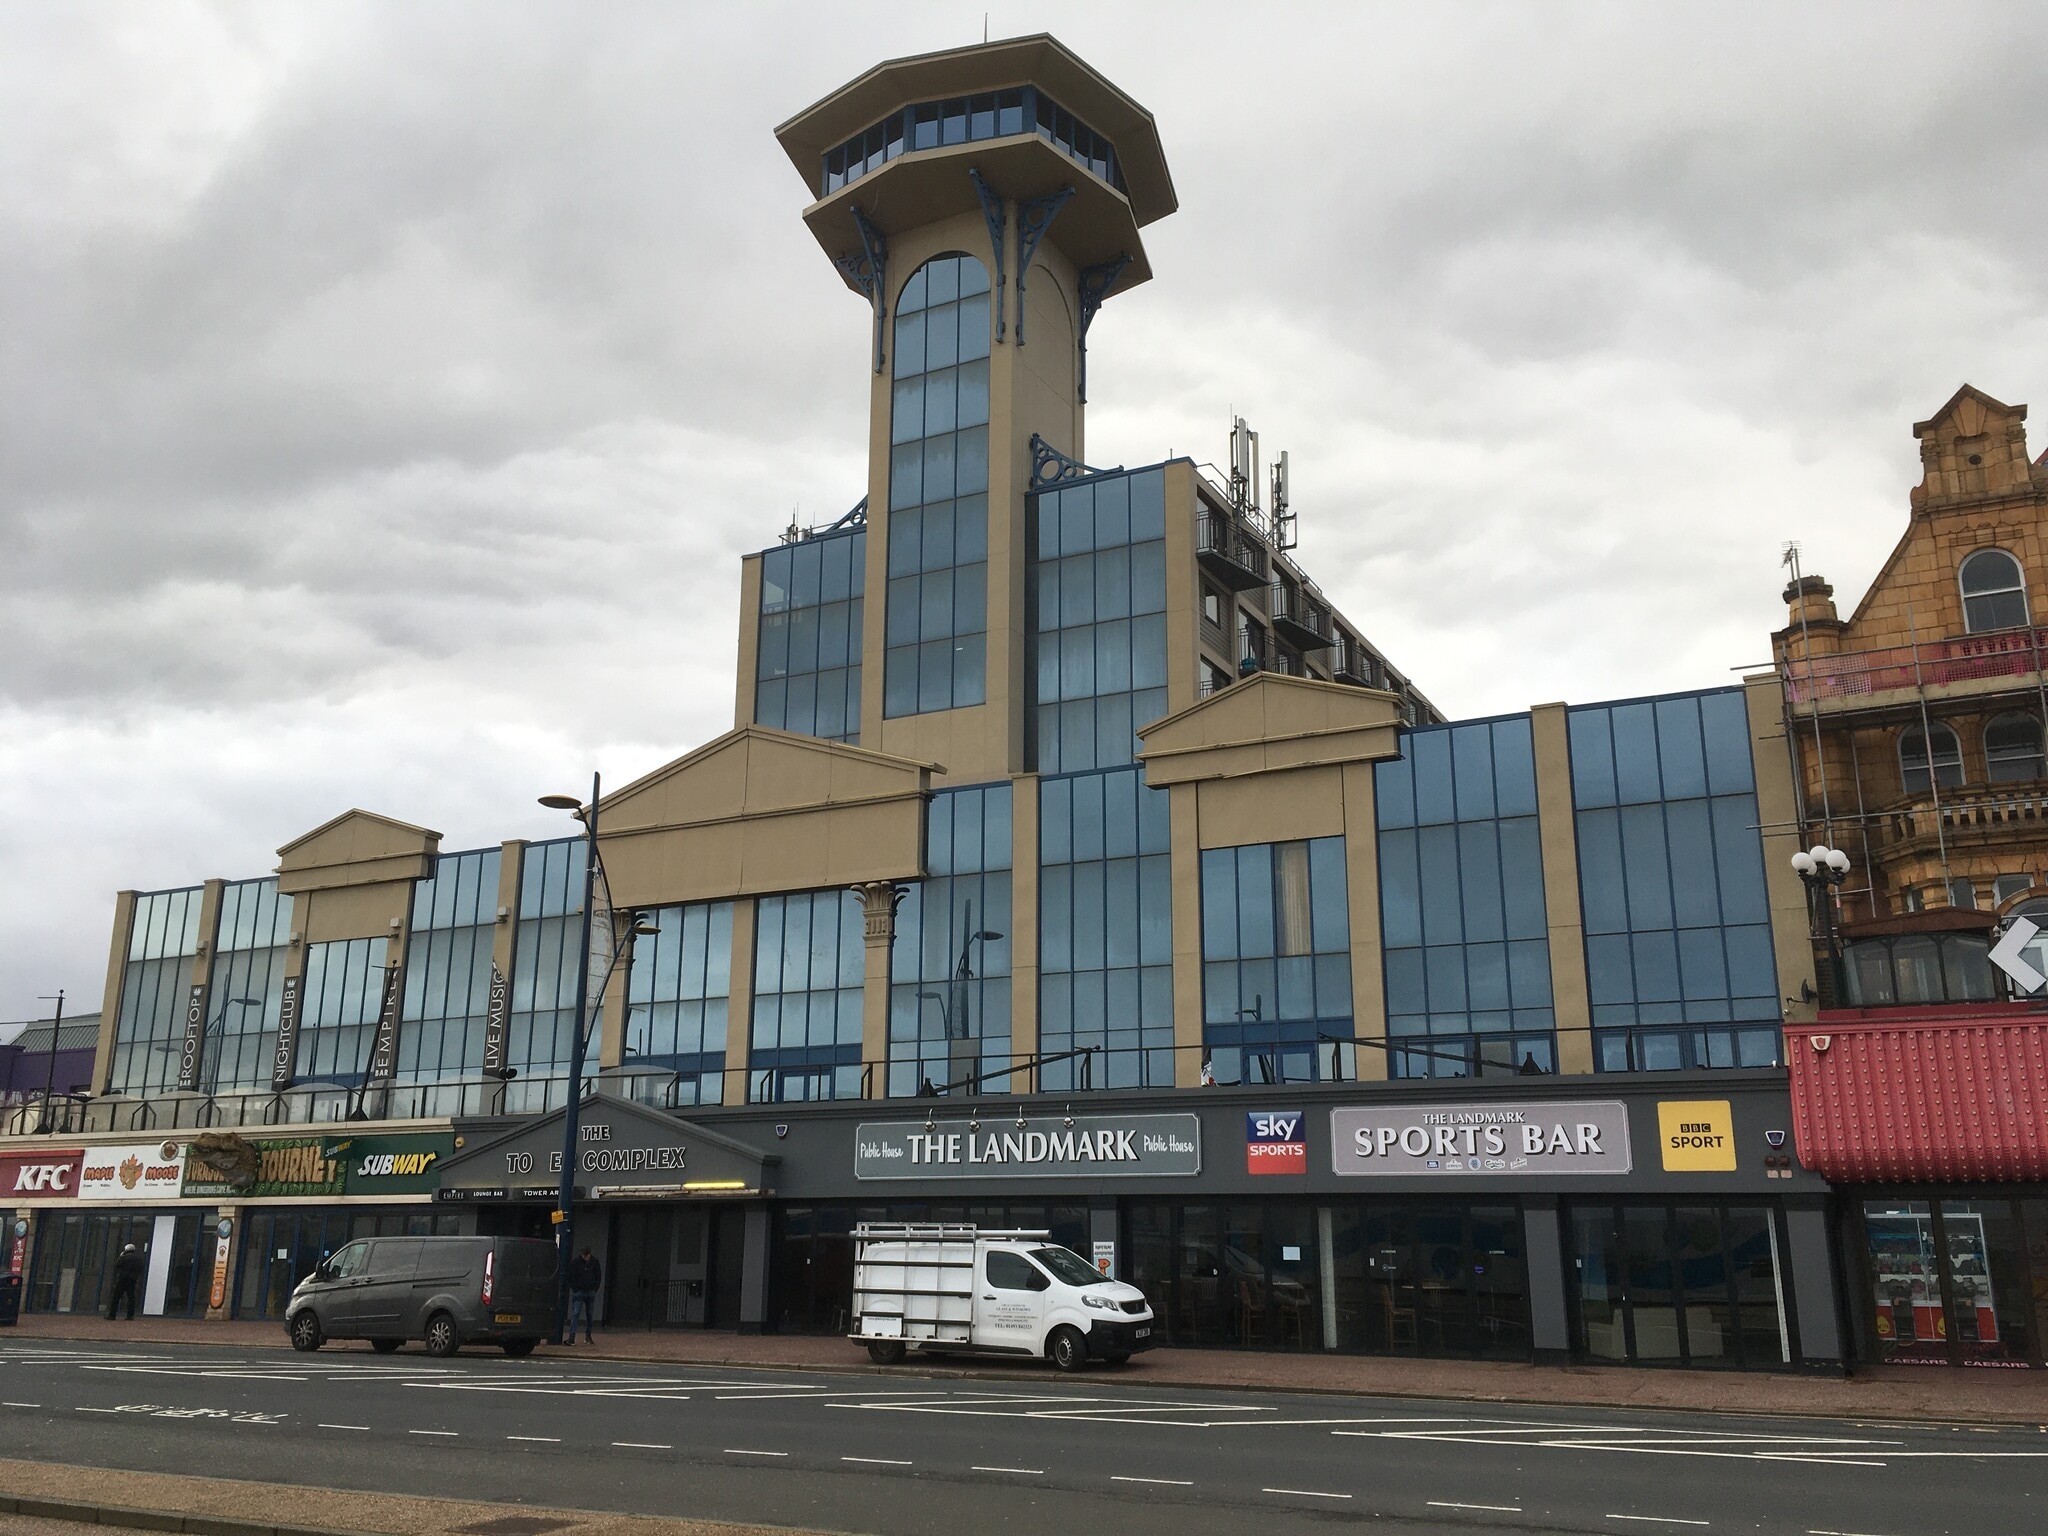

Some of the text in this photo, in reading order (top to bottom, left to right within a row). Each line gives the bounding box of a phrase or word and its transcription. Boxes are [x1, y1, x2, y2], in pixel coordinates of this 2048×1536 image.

[486, 971, 505, 1068] LIVE MUSIC
[181, 998, 201, 1082] ROOFTOP
[275, 989, 295, 1082] NIGHTCLUB
[374, 1069, 389, 1077] BAR
[1422, 1112, 1525, 1124] THE LANDMARK
[582, 1125, 611, 1141] THE
[1256, 1114, 1297, 1141] sky
[1681, 1124, 1711, 1133] BBC
[325, 1140, 353, 1157] SUBWAY
[906, 1130, 1138, 1163] THE LANDMARK
[1143, 1134, 1195, 1153] Public House
[1355, 1123, 1605, 1157] SPORTS BAR
[1671, 1136, 1723, 1148] SPORT
[860, 1141, 904, 1158] Public House
[1250, 1145, 1303, 1156] SPORTS
[357, 1151, 437, 1176] SUBWAY
[582, 1146, 686, 1172] COMPLEX
[13, 1164, 71, 1191] KFC
[84, 1165, 180, 1181] MAPLE MOOSE
[1884, 1357, 1948, 1365] CAESARS
[1964, 1360, 2030, 1368] CAESARS
